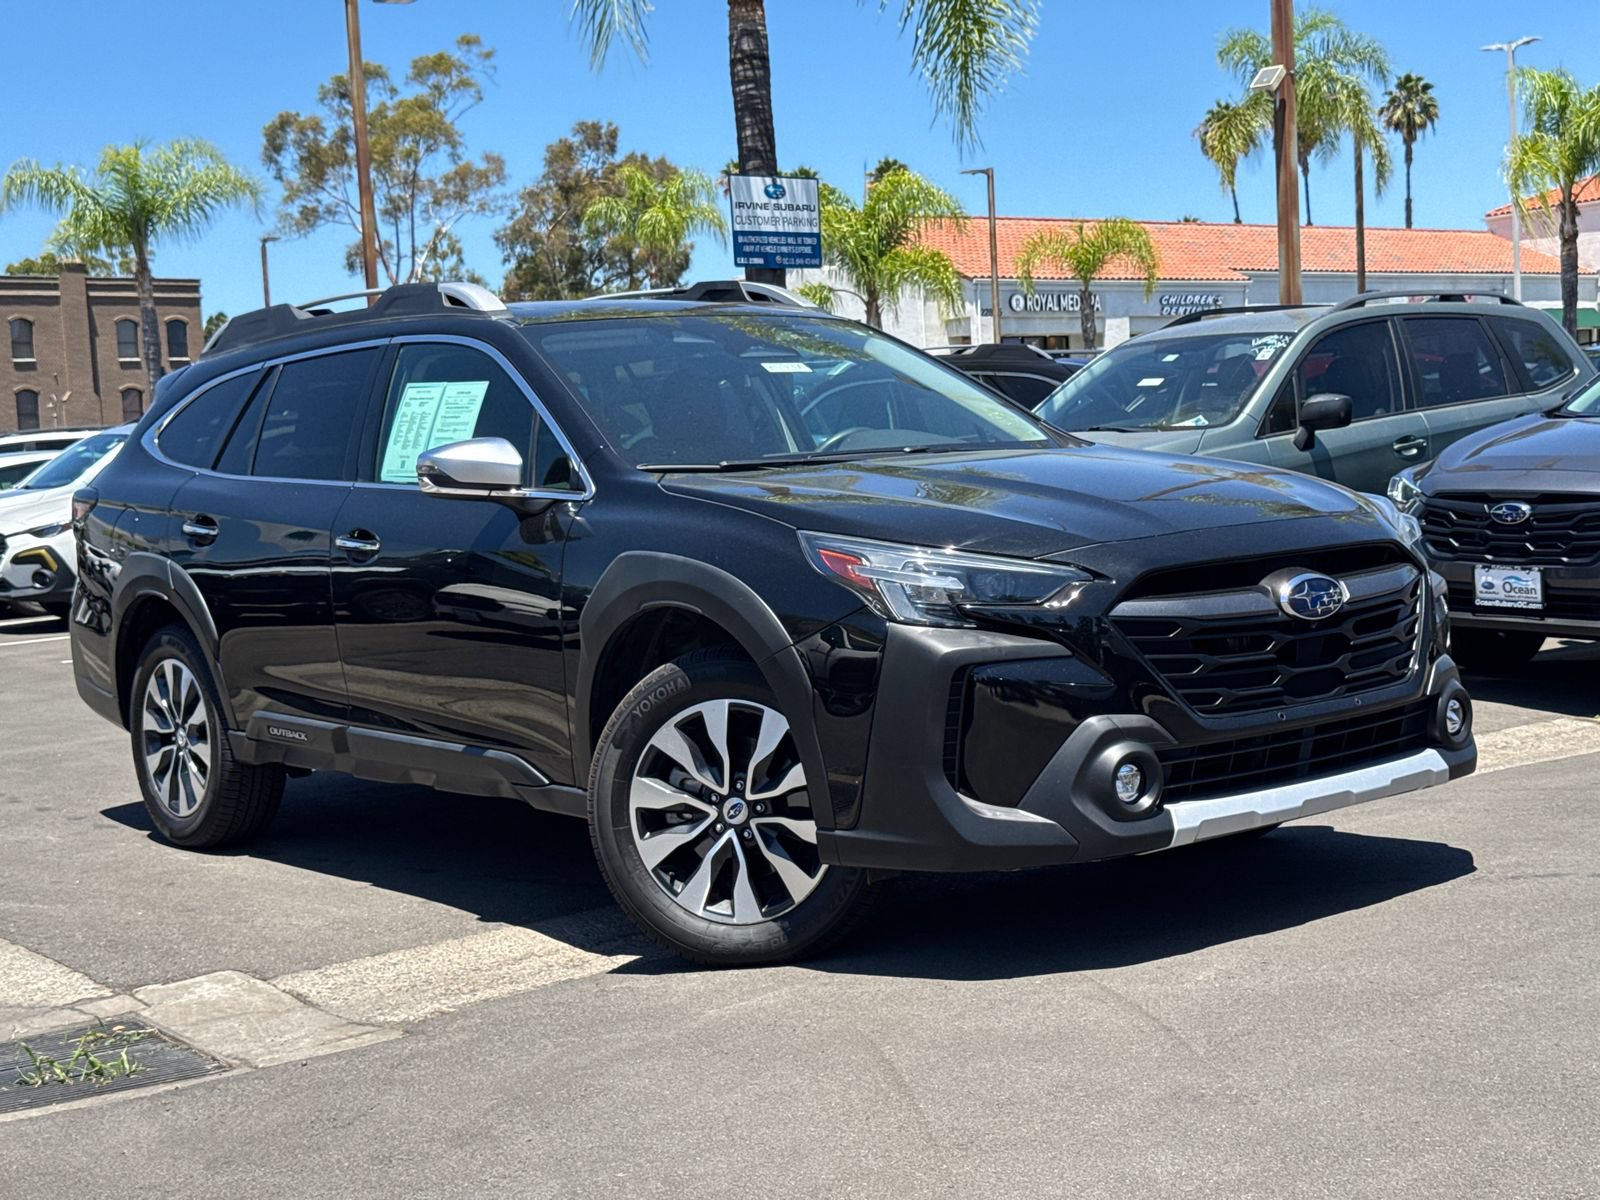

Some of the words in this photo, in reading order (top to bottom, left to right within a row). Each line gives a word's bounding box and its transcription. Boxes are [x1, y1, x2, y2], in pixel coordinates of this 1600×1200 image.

[735, 201, 770, 211] IRVINE
[773, 203, 816, 212] SUBARU
[735, 215, 780, 226] CUSTOMER
[782, 216, 818, 227] PARKING
[1027, 294, 1059, 312] ROYAL
[1060, 294, 1080, 311] MED
[1161, 294, 1224, 306] CHILDREN'S
[1502, 581, 1537, 595] Ocean
[632, 677, 691, 718] YOKOHA
[269, 727, 308, 741] OUTBACK
